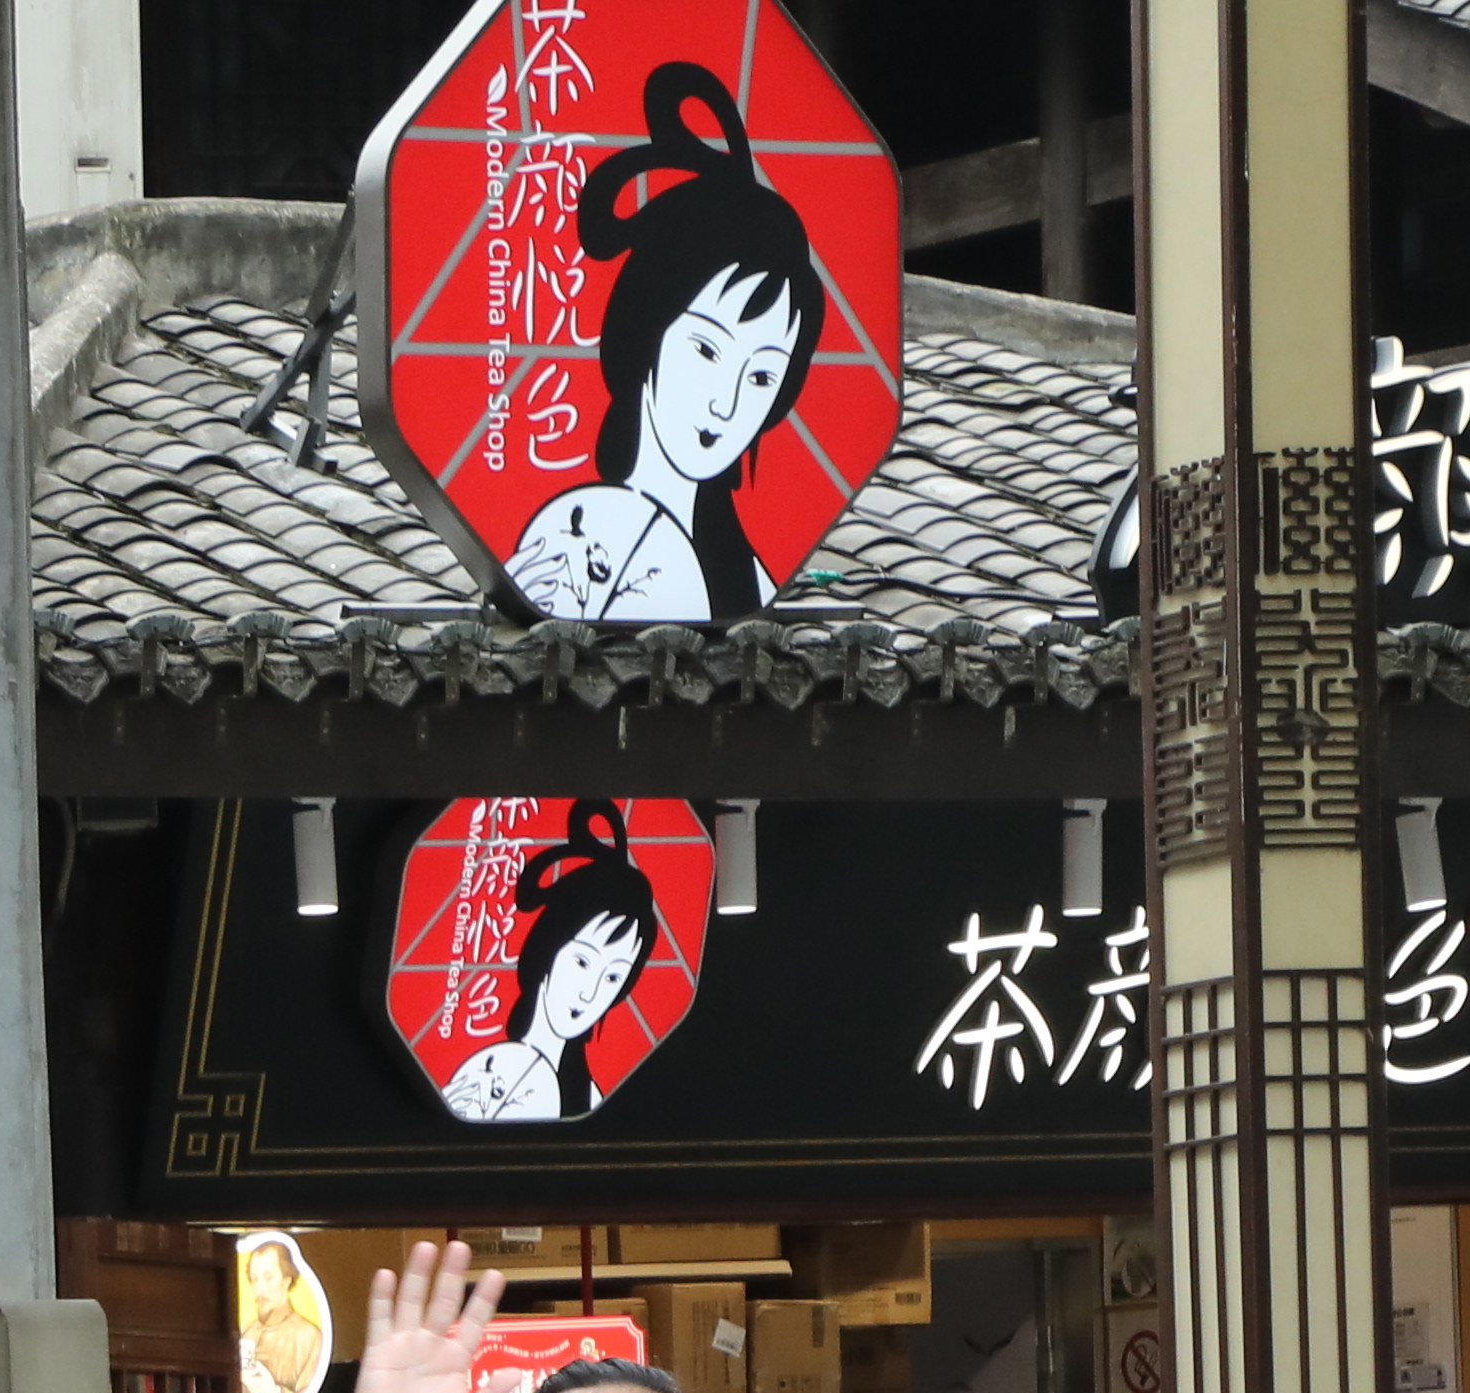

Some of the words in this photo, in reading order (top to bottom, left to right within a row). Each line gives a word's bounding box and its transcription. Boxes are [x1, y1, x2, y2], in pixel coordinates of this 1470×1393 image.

[484, 106, 510, 233] Modern
[487, 238, 511, 326] China
[487, 331, 511, 387] Tea
[486, 392, 512, 472] Shop
[458, 824, 484, 900] Modern
[452, 902, 473, 954] China
[447, 955, 465, 990] Tea
[438, 989, 460, 1040] Shop
